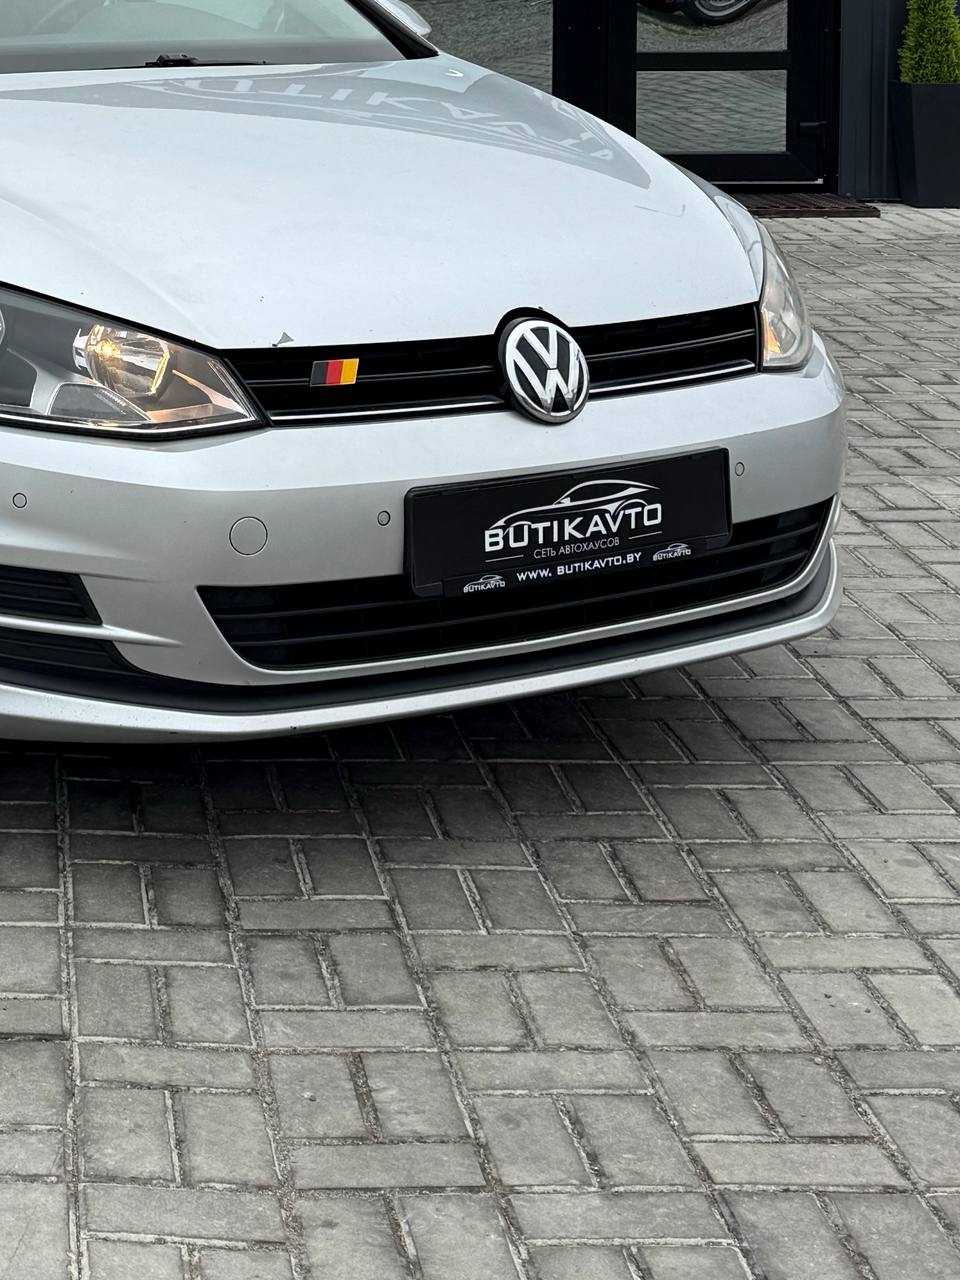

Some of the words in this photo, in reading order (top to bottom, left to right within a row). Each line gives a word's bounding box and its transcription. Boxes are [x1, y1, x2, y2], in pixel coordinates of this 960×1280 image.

[484, 503, 662, 553] BUTIKAVTO
[533, 548, 557, 559] СЕТЬ
[558, 537, 620, 556] АВТОХАУСОВ
[652, 549, 692, 561] BUTIKAVTO
[516, 568, 552, 582] WWW.
[556, 552, 642, 576] BUTIKAVTO.BY
[463, 580, 506, 593] BUTIKAVTO
